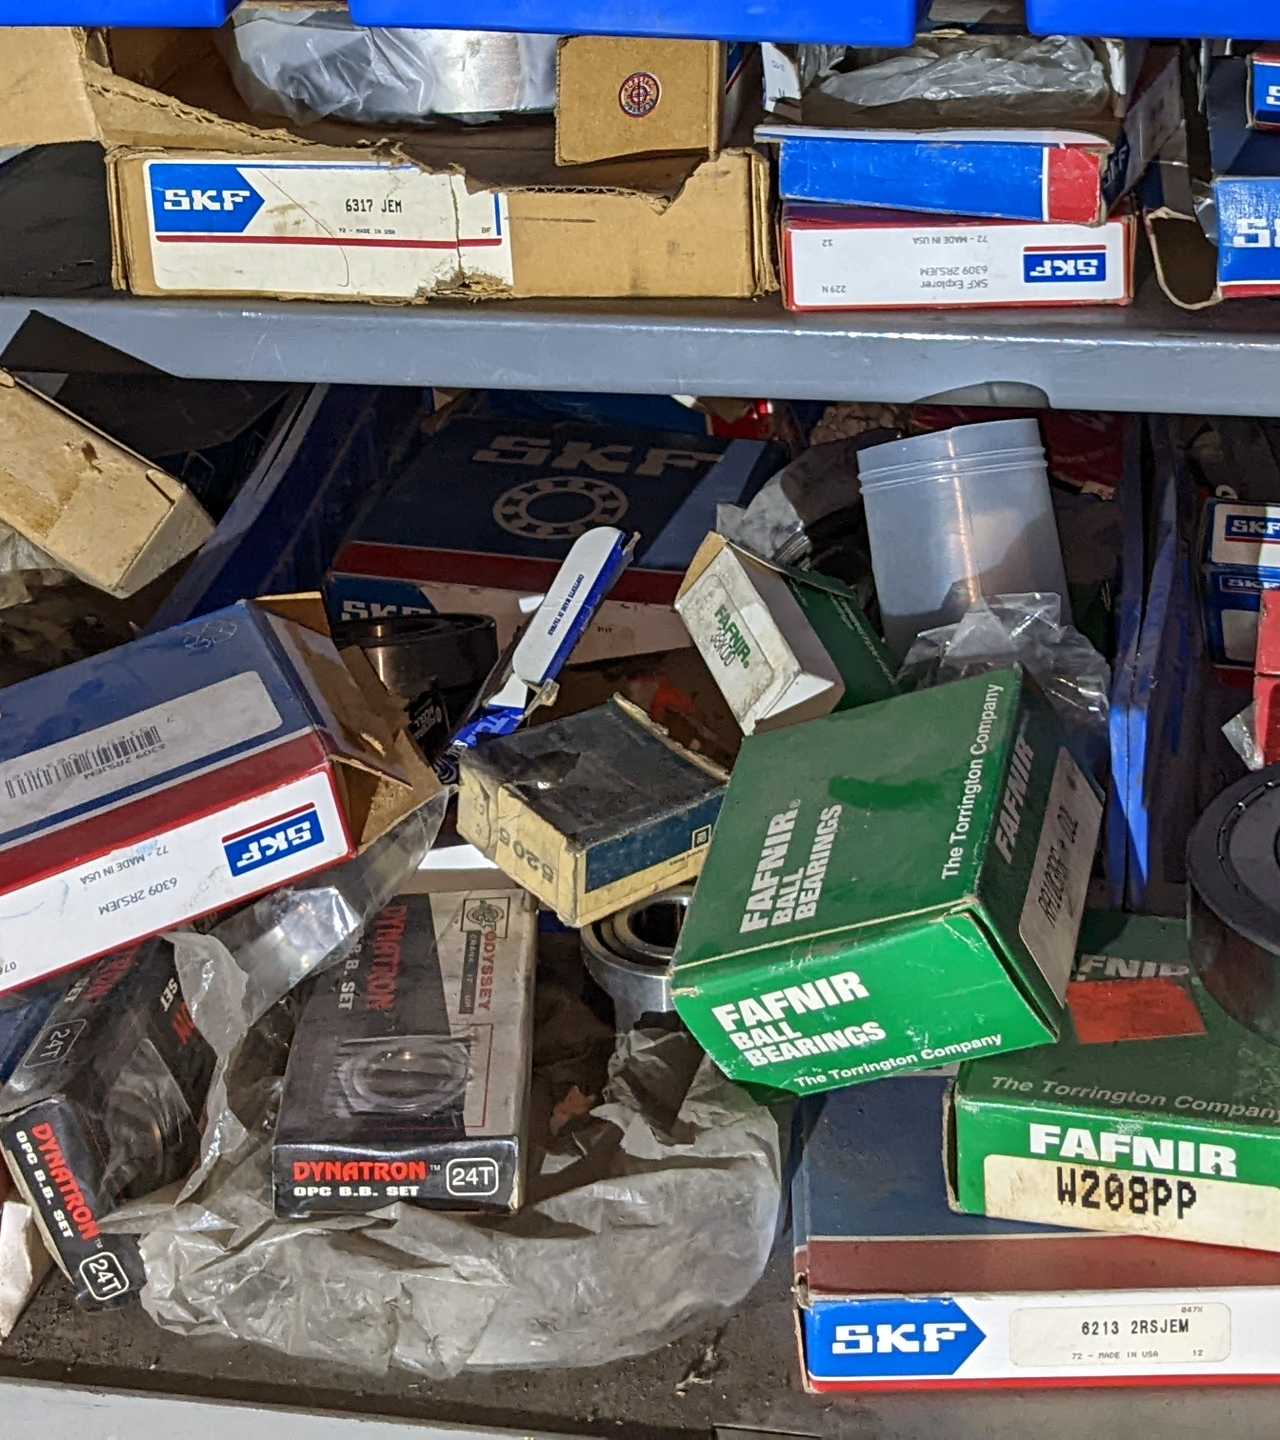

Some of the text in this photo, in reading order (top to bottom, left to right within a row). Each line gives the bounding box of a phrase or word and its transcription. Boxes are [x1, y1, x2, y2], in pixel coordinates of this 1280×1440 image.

[164, 188, 251, 213] SKF
[345, 197, 402, 215] 6317 JEM
[912, 234, 969, 245] MADE USA
[920, 277, 989, 290] SKF Explorer
[1030, 258, 1099, 277] SKF
[472, 435, 725, 479] SKF
[340, 600, 436, 622] SKF
[714, 603, 751, 666] FAFNIR
[942, 682, 1005, 880] The Torrington Company
[995, 735, 1036, 864] FAFNIR
[237, 818, 314, 869] SKF
[794, 803, 843, 921] BEARINGS
[78, 853, 146, 885] MADE USA
[739, 807, 797, 934] FAFNIR
[96, 876, 179, 916] 6309 2RSJEM
[770, 867, 804, 927] BALL
[368, 903, 409, 1011] DYNATRON
[476, 926, 497, 1012] ODYSSEY
[337, 981, 356, 1011] SET
[711, 971, 871, 1033] FAFNIR
[728, 1020, 801, 1052] BALL
[743, 1020, 888, 1068] BEARINGS
[794, 1031, 1004, 1089] The Torrington Company
[991, 1074, 1034, 1095] The
[1039, 1078, 1169, 1109] Torrington
[1028, 1122, 1238, 1178] FAFNIR
[16, 1129, 76, 1240] OPC B.B. SET
[28, 1121, 103, 1242] DYNATRON
[293, 1161, 427, 1182] DYNATRON
[451, 1166, 495, 1190] 24T
[293, 1185, 420, 1198] OPC B.B. SET
[1056, 1166, 1197, 1219] W208PP
[87, 1259, 122, 1294] 24T
[831, 1323, 967, 1355] SKF
[1081, 1318, 1191, 1337] 6213 2RSJEM
[1097, 1351, 1121, 1360] MADE
[1125, 1351, 1137, 1359] IN
[1141, 1350, 1159, 1359] USA
[1192, 1349, 1204, 1358] 12
